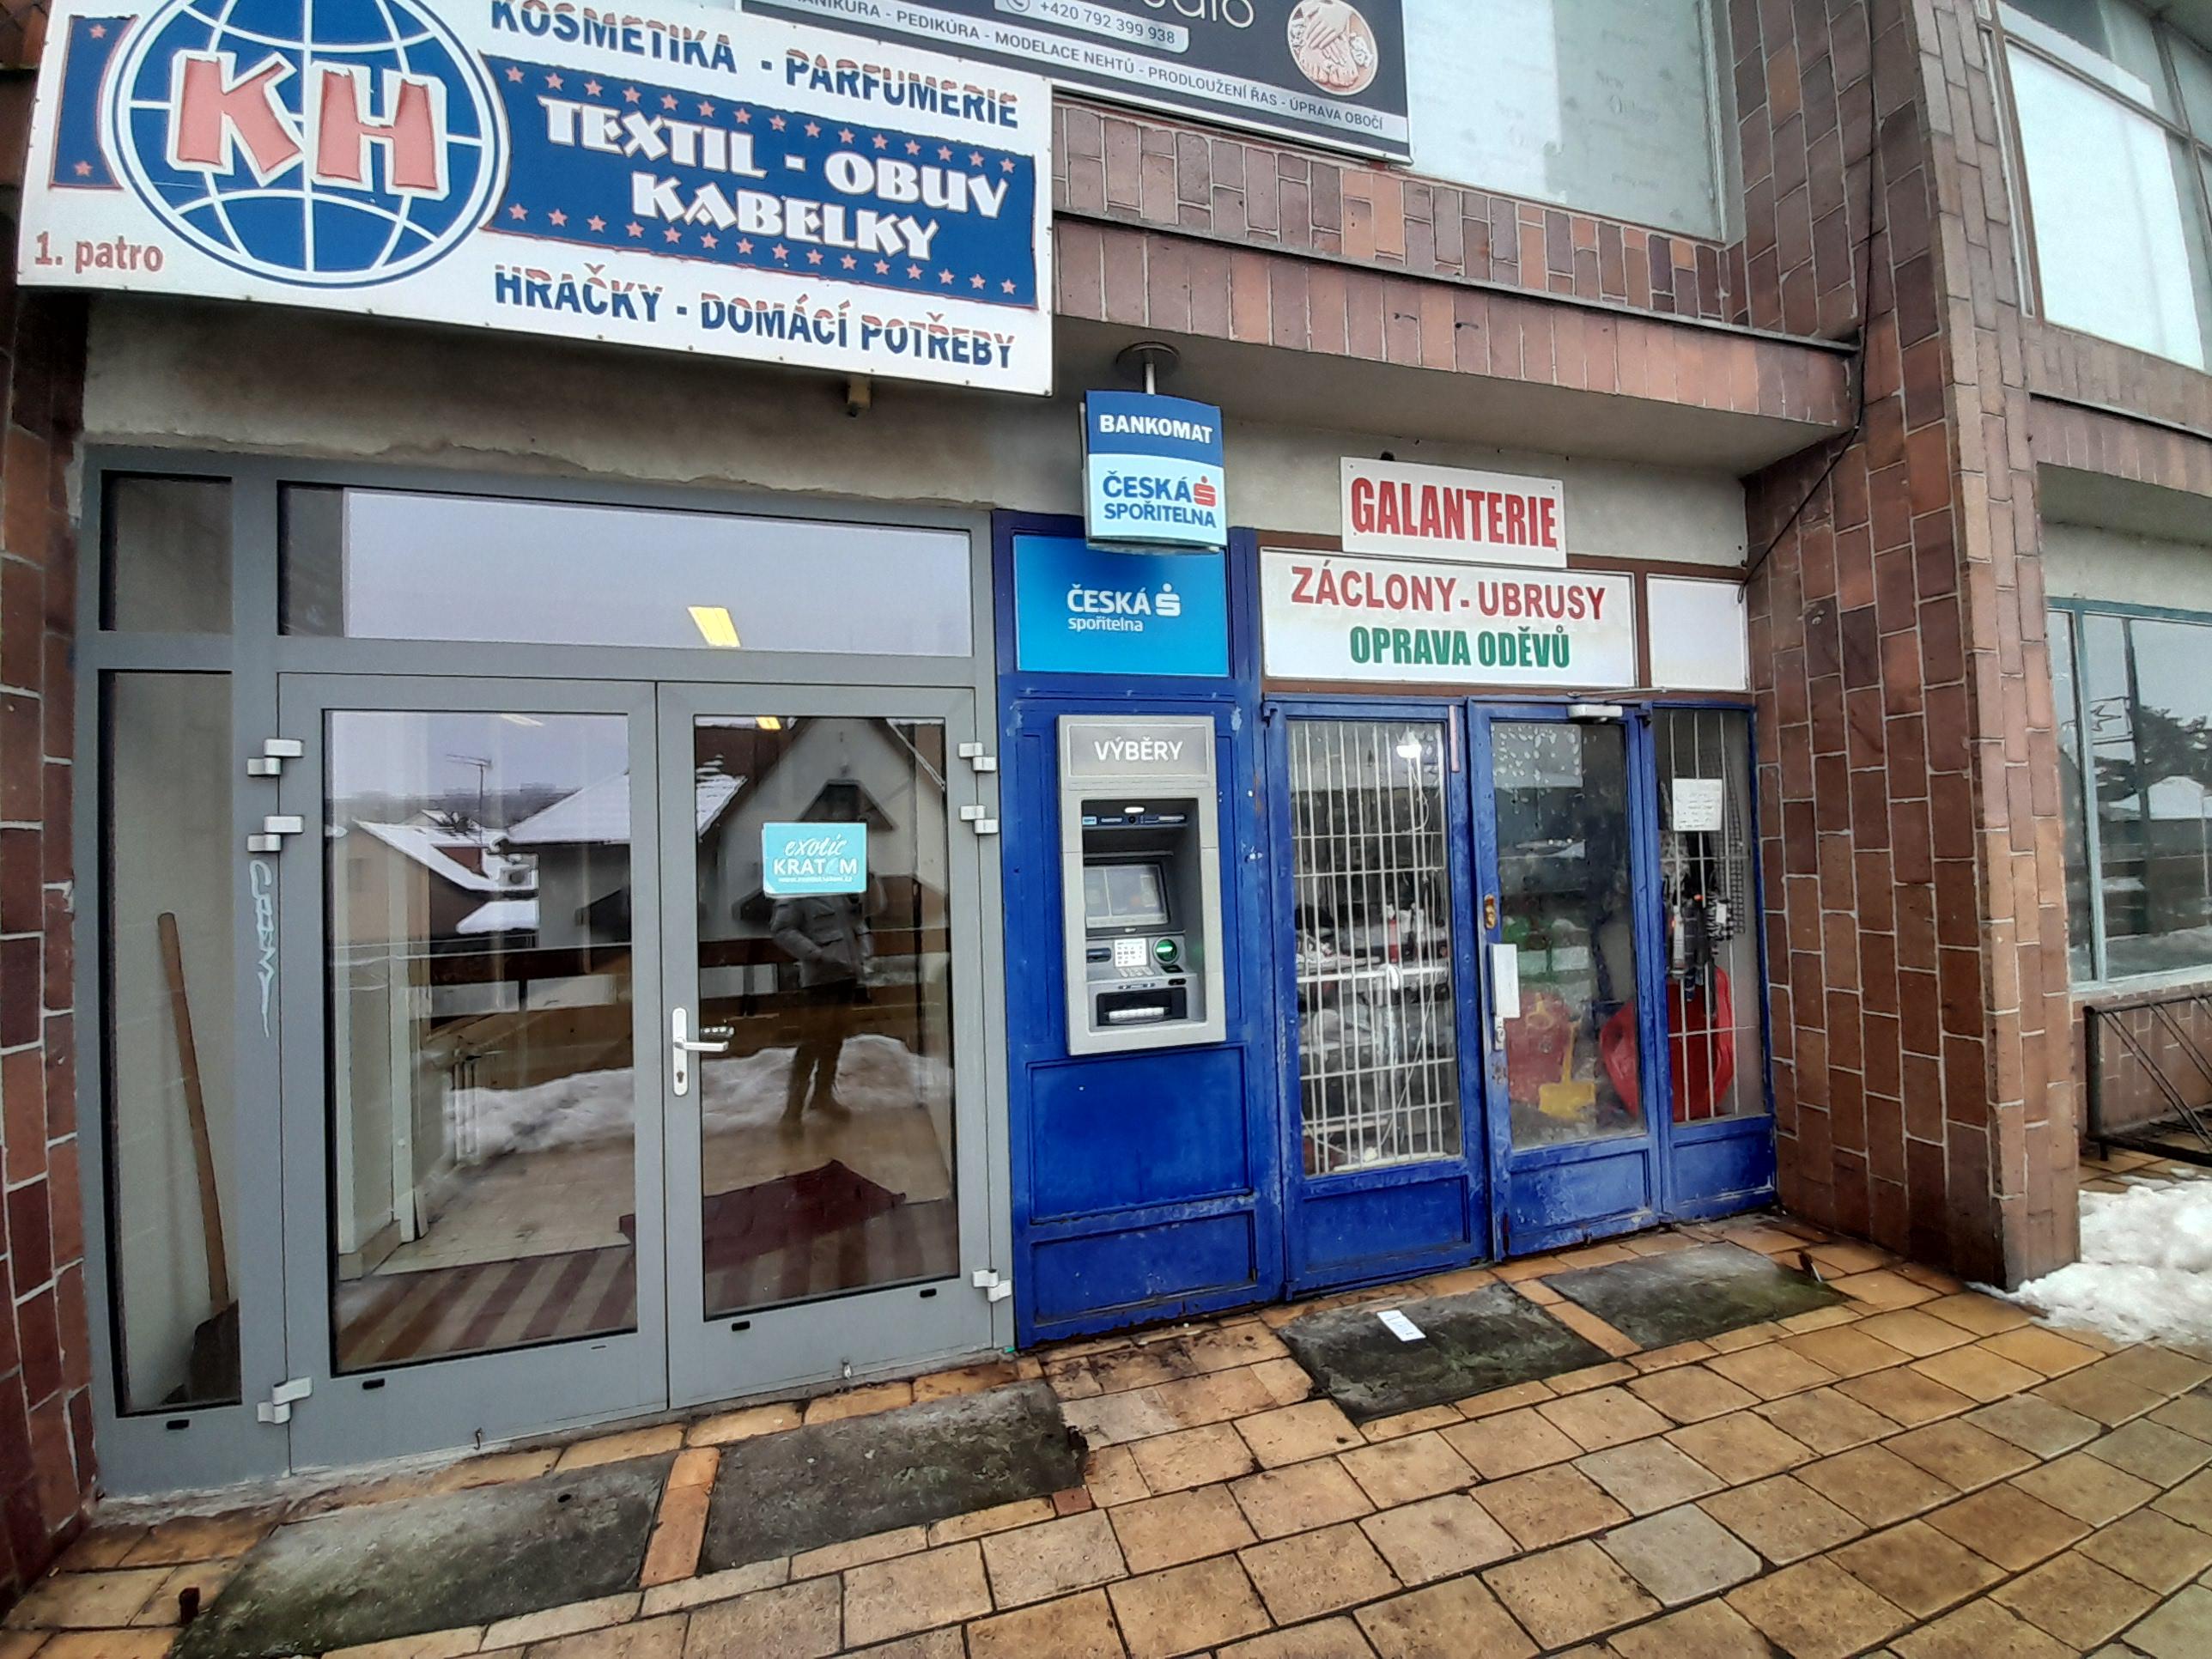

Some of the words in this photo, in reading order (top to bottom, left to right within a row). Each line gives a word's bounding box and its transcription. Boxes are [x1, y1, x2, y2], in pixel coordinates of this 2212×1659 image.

[1040, 2, 1079, 20] +420
[1085, 9, 1111, 28] 792
[1117, 19, 1144, 37] 399
[1148, 27, 1175, 44] 938
[491, 0, 737, 74] KOSMETIKA
[786, 48, 1018, 129] PARFUMERIE
[995, 31, 1079, 61] MODELACE
[1149, 66, 1247, 100] PRODLOUŽENÍ
[1250, 88, 1277, 106] ŘAS
[1289, 96, 1341, 121] ÚPRAVA
[1345, 112, 1383, 130] OBOČÍ
[172, 52, 443, 196] KH
[538, 95, 767, 179] TEXTIL
[824, 151, 1008, 219] OBUV
[631, 170, 939, 260] KABELKY
[34, 231, 62, 265] 1.
[76, 236, 163, 273] patro
[495, 262, 663, 323] HRAČKY
[701, 294, 850, 348] DOMÁCÍ
[861, 311, 1014, 369] POTŘEBY
[1099, 414, 1213, 444] BANKOMAT
[1103, 471, 1192, 503] ČESKÁ
[1104, 500, 1217, 528] SPOŘITELNA
[1350, 476, 1559, 549] GALANTERIE
[1066, 583, 1152, 616] ČESKÁ
[1291, 560, 1456, 612] ZÁCLONY
[1478, 580, 1607, 620] UBRUSY
[1067, 614, 1144, 632] spořitelna
[1349, 625, 1471, 666] OPRAVA
[1478, 624, 1571, 668] ODĚVŮ
[1094, 736, 1183, 761] VÝBĚRY
[785, 834, 848, 856] exotic
